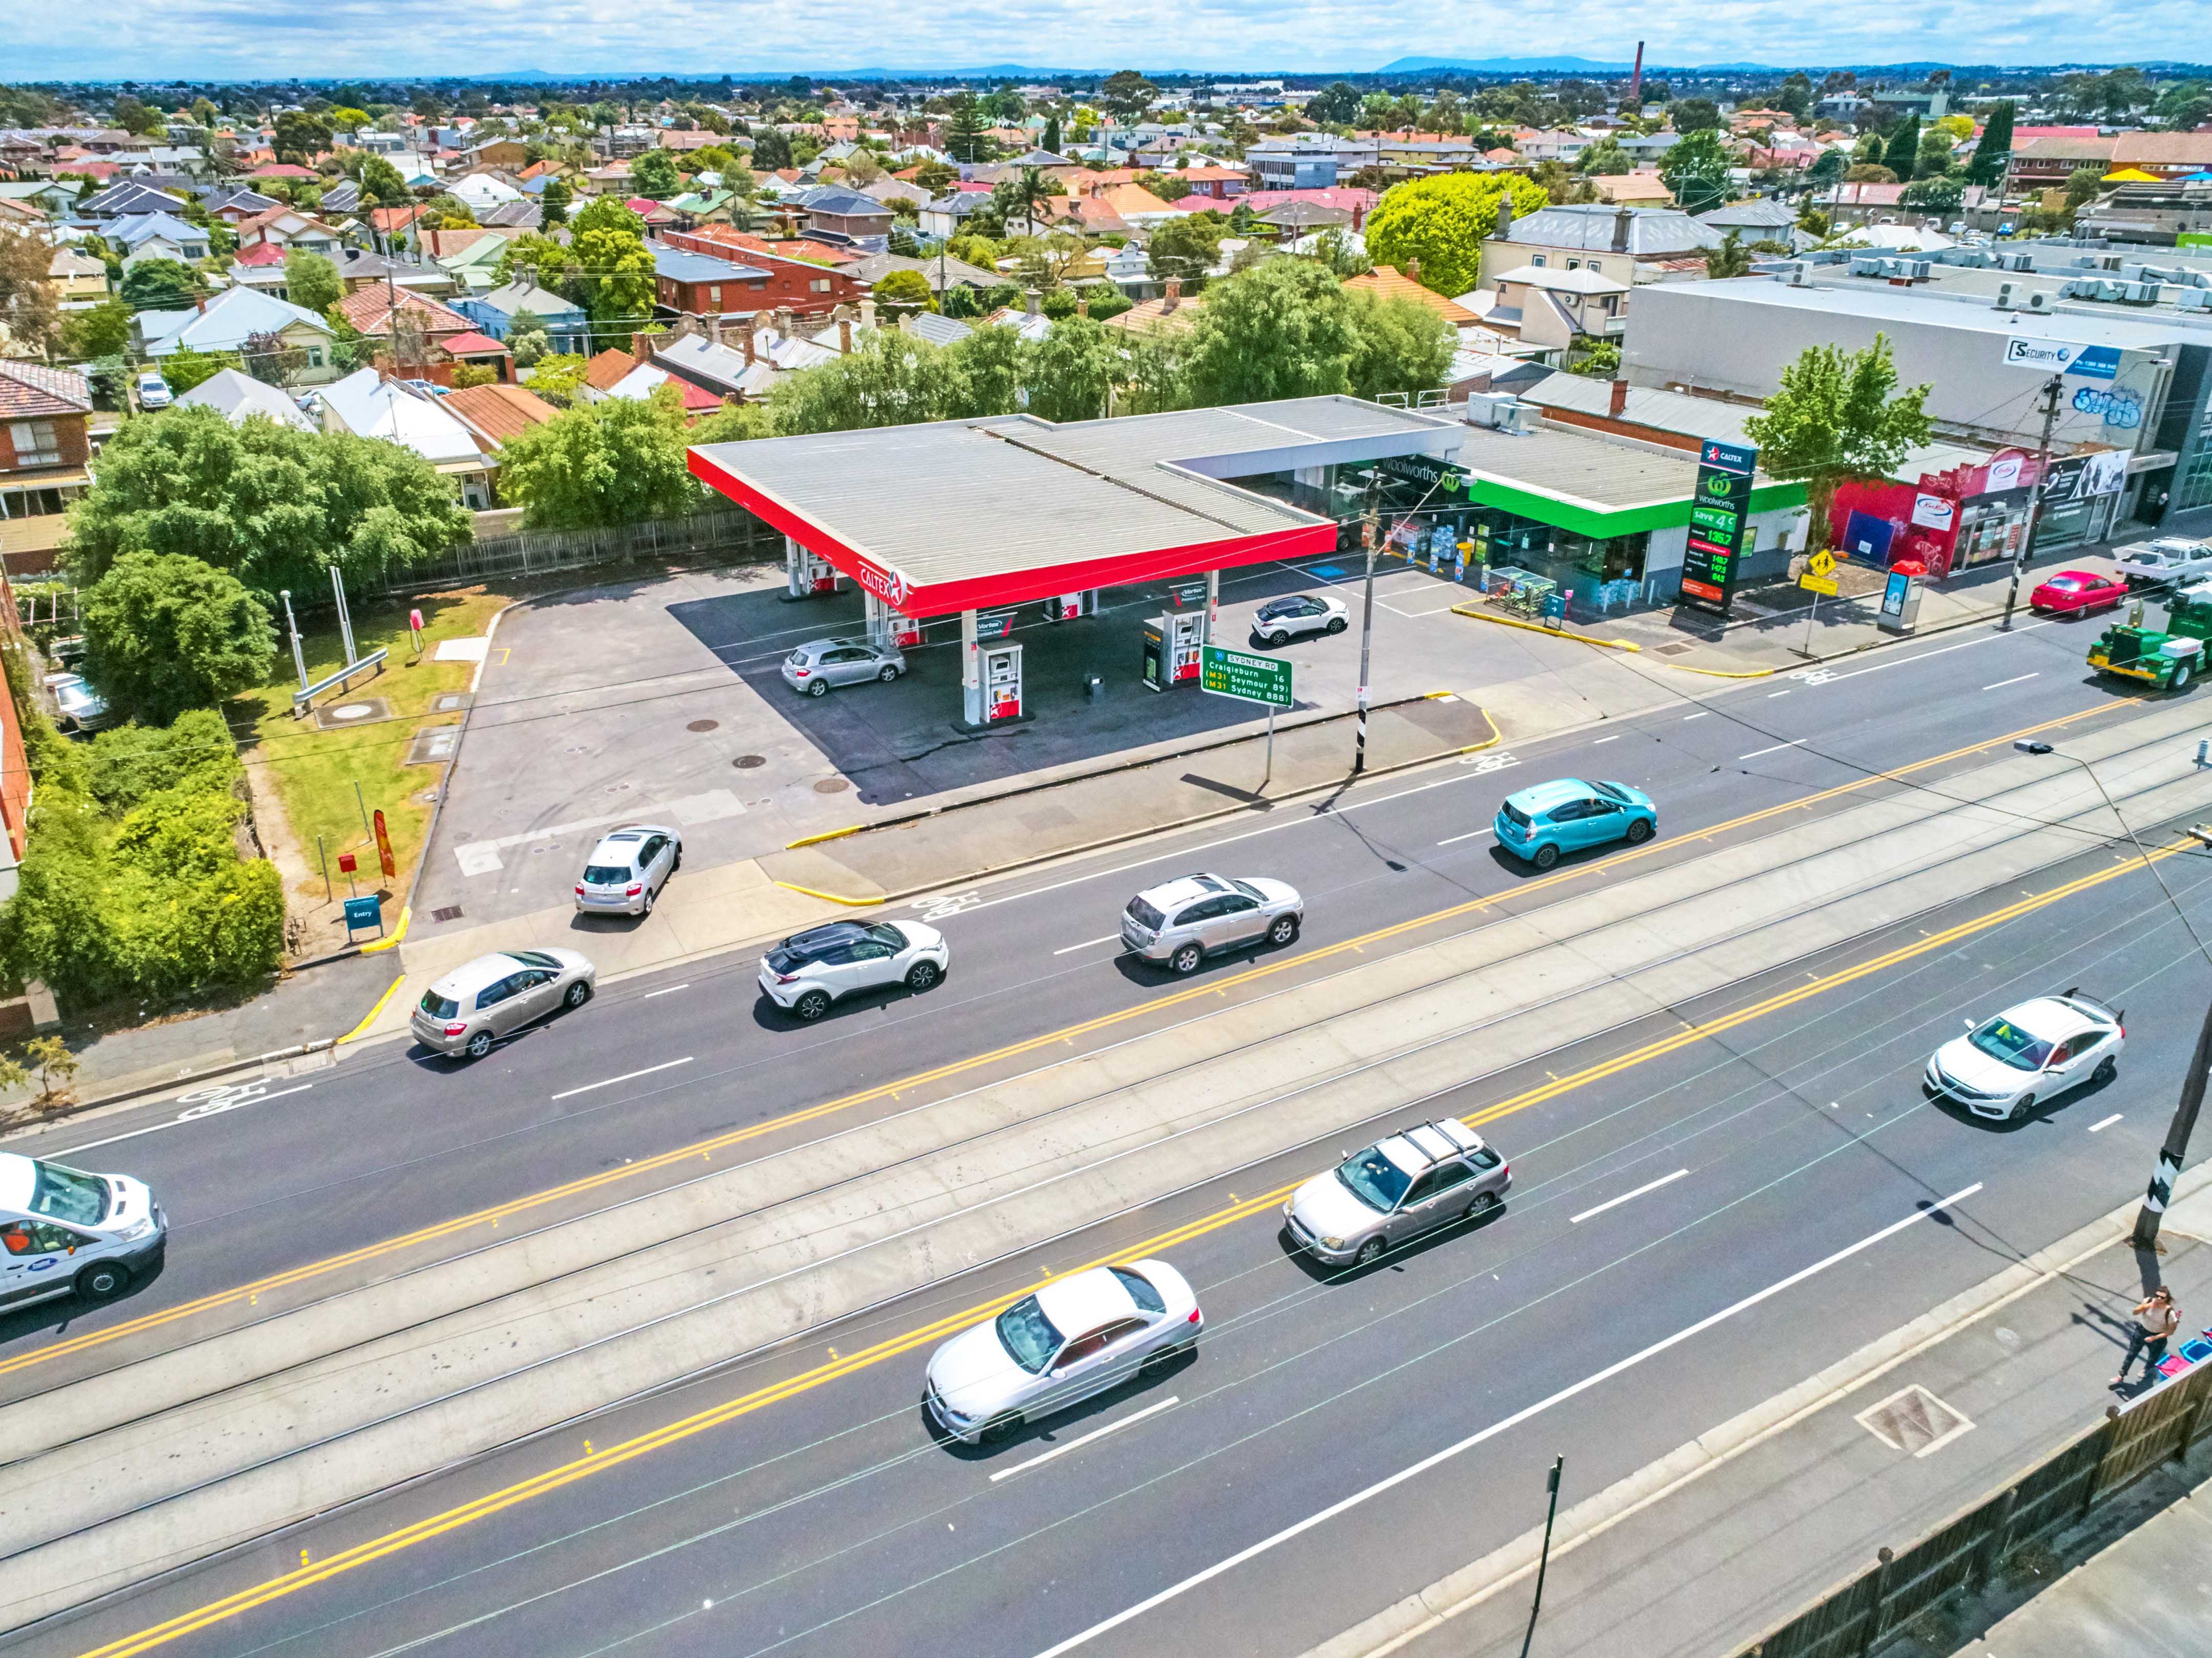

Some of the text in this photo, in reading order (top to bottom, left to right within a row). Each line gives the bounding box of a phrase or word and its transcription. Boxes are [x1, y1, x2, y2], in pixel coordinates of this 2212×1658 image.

[1720, 453, 1742, 463] CALTEX
[1383, 457, 1438, 483] Woolworths
[1699, 495, 1735, 510] Woolworths
[1694, 511, 1714, 522] save
[1716, 515, 1726, 528] 4
[861, 568, 890, 599] CALTEX
[1209, 661, 1258, 678] Craigieburn
[1229, 655, 1262, 667] SYDNEY
[1231, 675, 1268, 689] Seymour
[1273, 683, 1288, 693] 89)
[1231, 685, 1262, 698] Sydney
[1267, 692, 1288, 702] 888)
